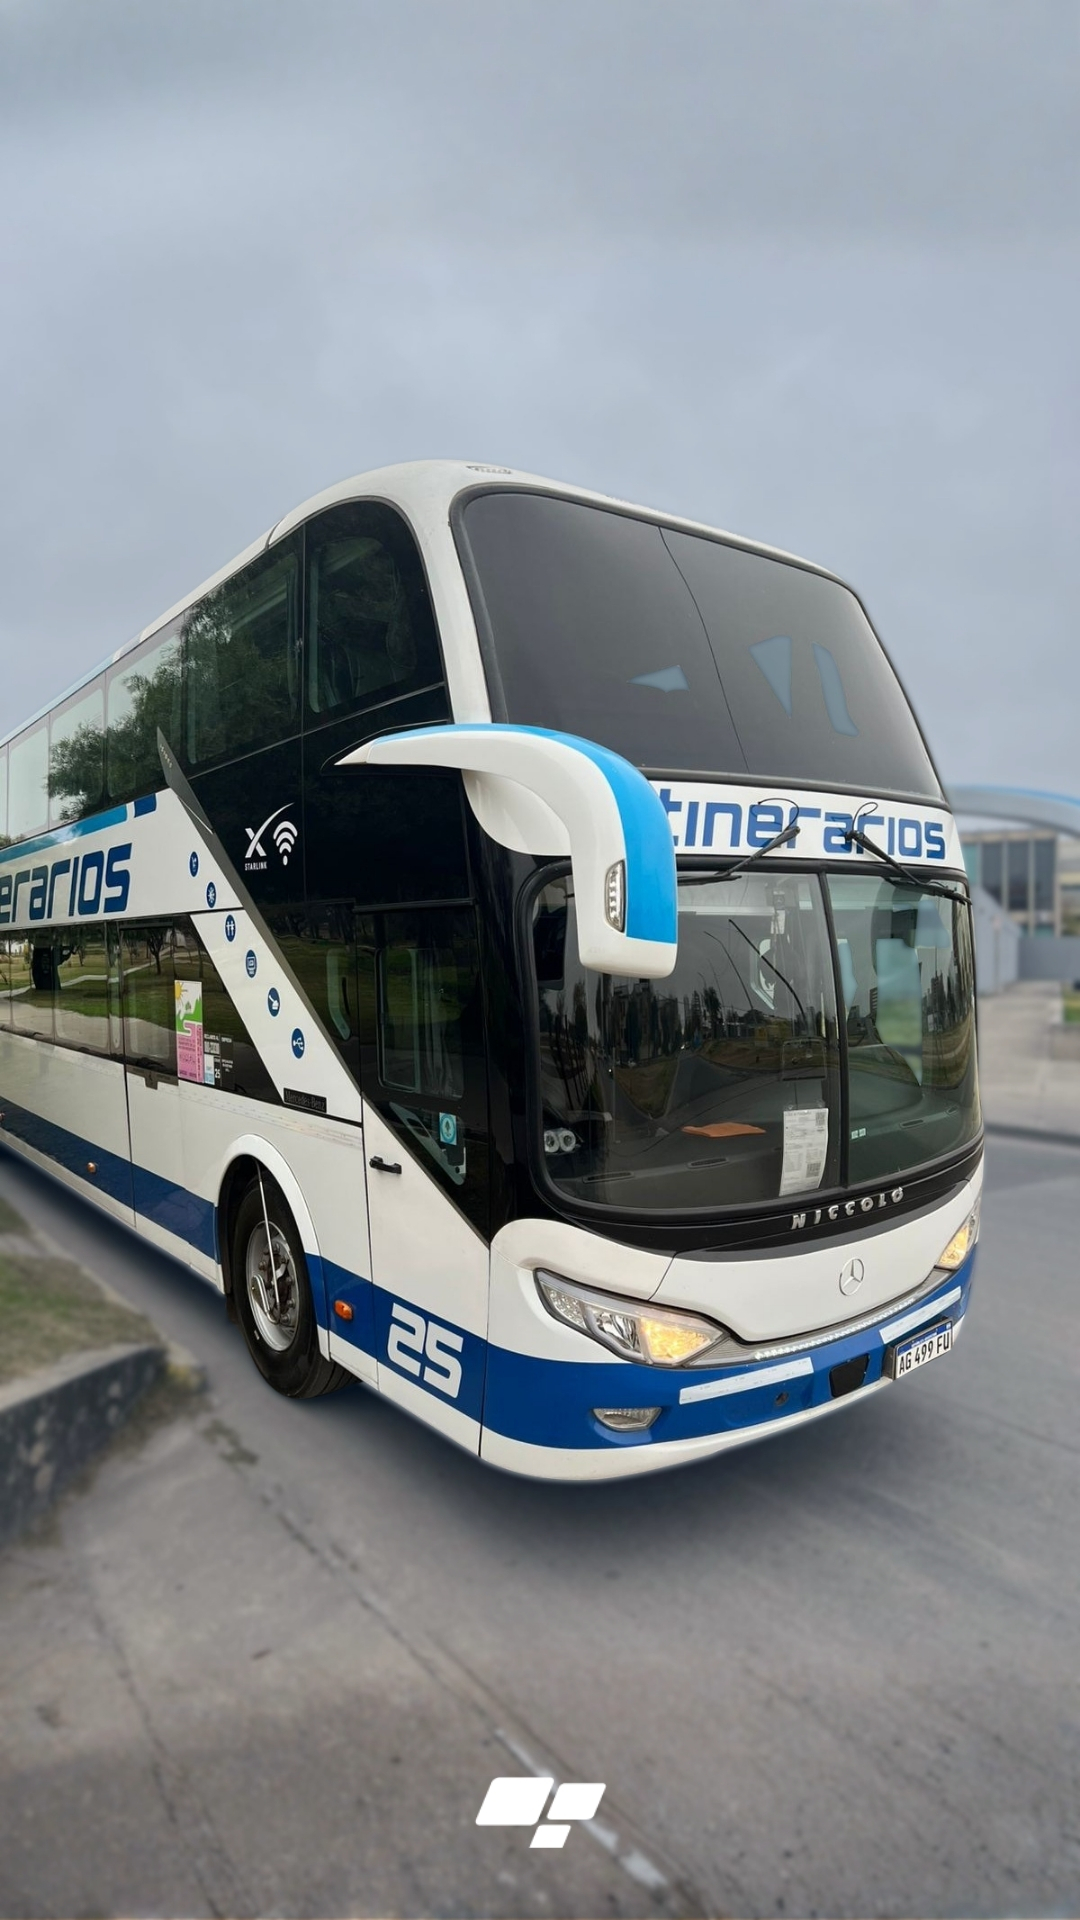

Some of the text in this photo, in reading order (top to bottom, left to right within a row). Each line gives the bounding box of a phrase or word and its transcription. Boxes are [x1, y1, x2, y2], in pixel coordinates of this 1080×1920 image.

[244, 861, 268, 872] STARLINK
[285, 1090, 325, 1111] Mercedes-Benz
[387, 1303, 463, 1398] 25
[899, 1352, 912, 1375] AG
[915, 1340, 934, 1364] 499
[937, 1332, 950, 1354] FU
